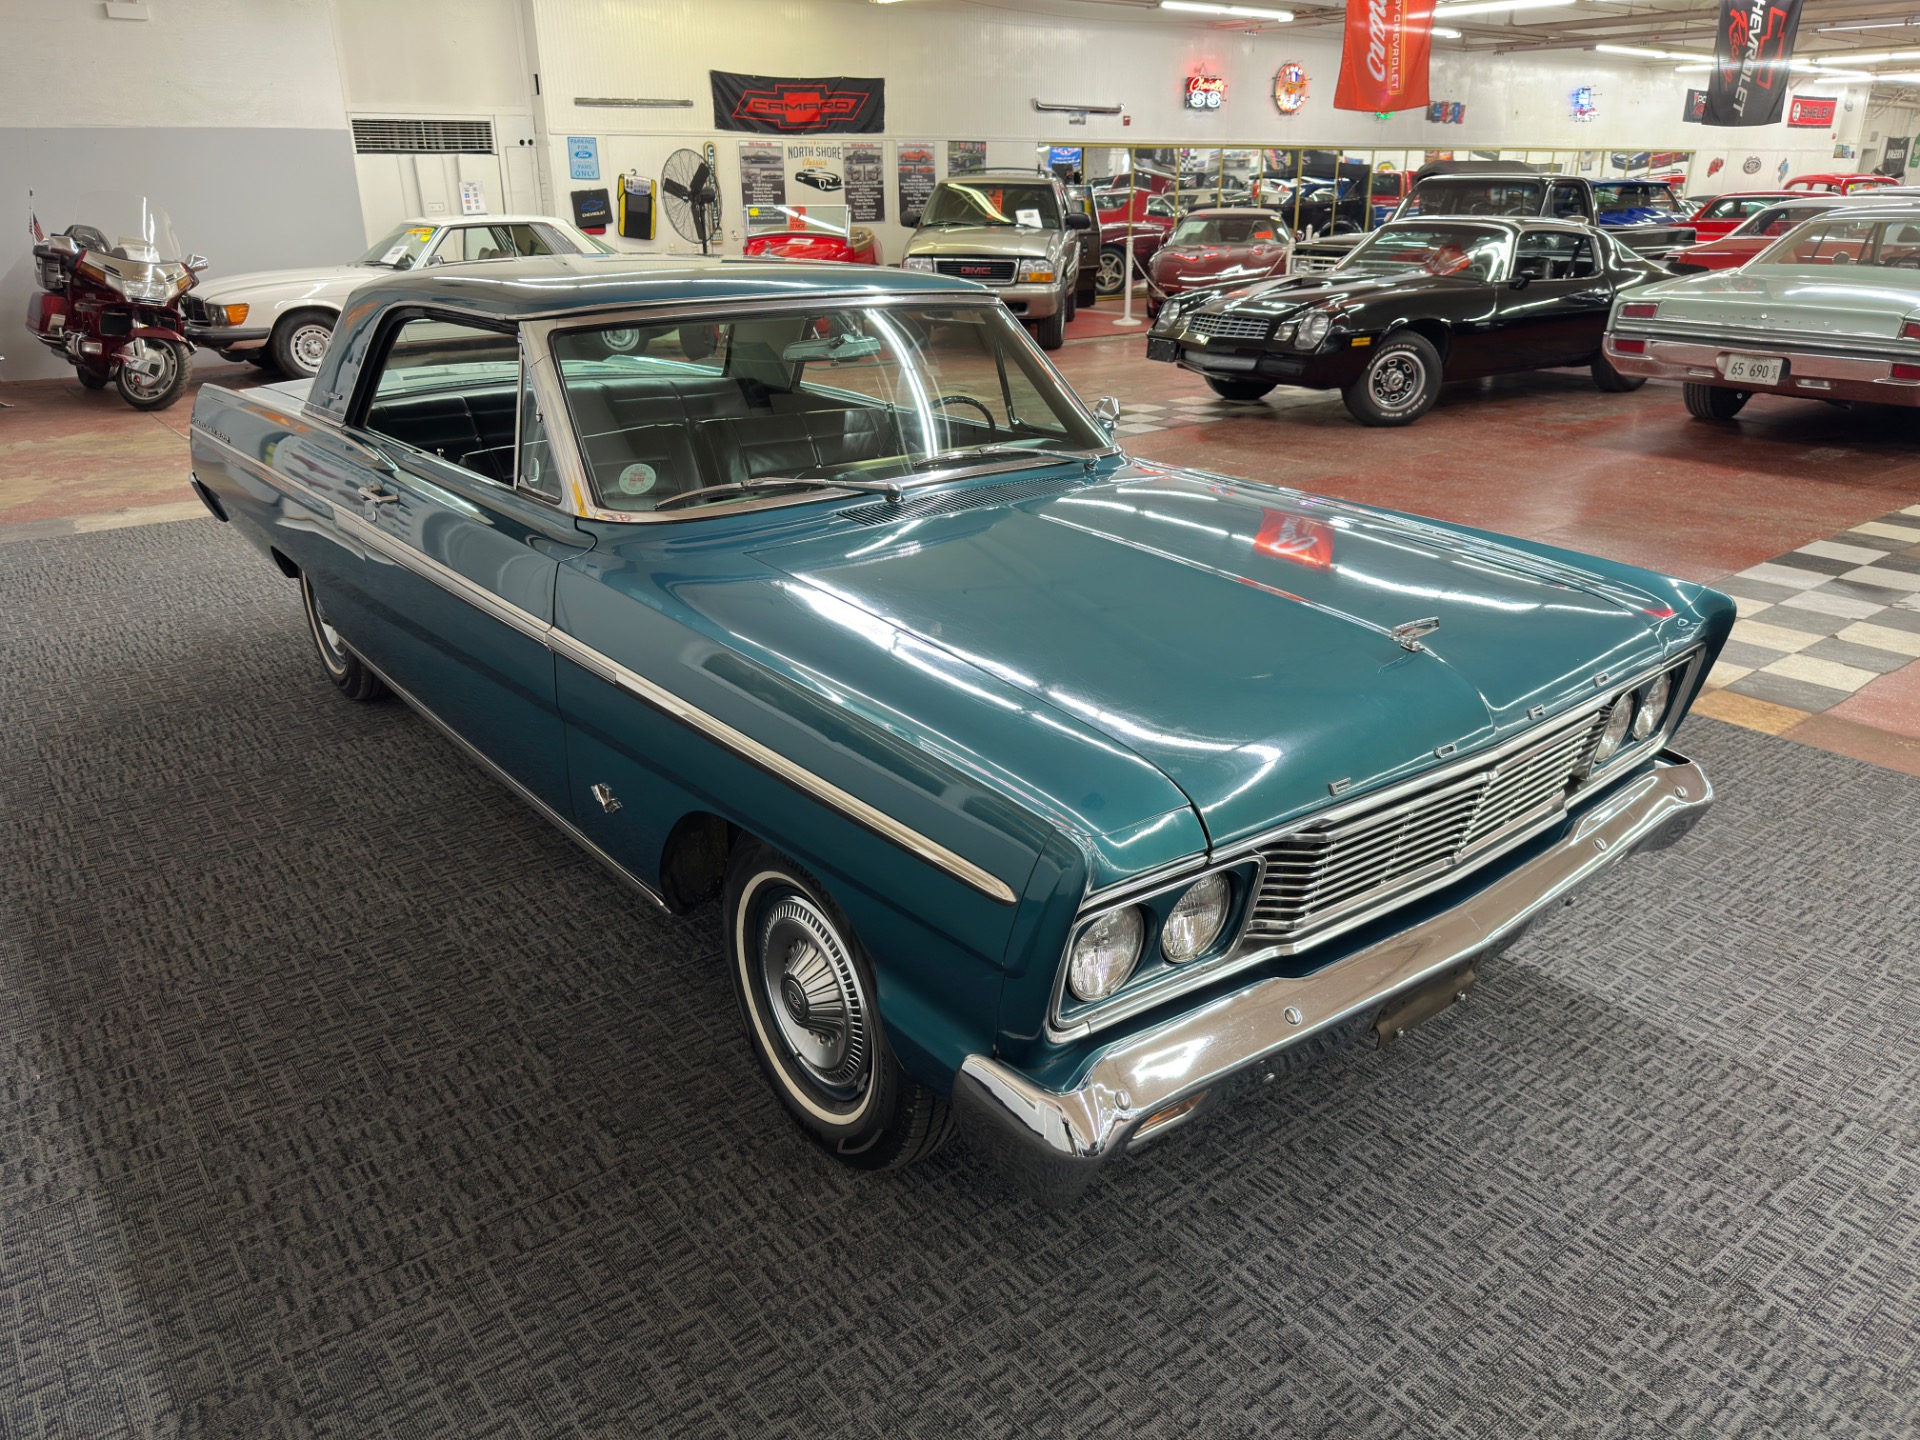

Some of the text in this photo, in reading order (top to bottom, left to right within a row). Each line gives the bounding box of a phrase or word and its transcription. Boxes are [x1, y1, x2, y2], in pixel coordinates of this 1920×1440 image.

[1391, 14, 1401, 89] CHEVROLET
[1190, 90, 1221, 108] SS
[752, 101, 850, 111] CAMARO
[1801, 106, 1832, 119] SHELBY
[788, 146, 842, 160] NORTH SHORE
[802, 158, 828, 166] Classics
[582, 210, 606, 218] CHEVROLET
[960, 266, 991, 275] GMC
[1731, 362, 1769, 378] 65 690
